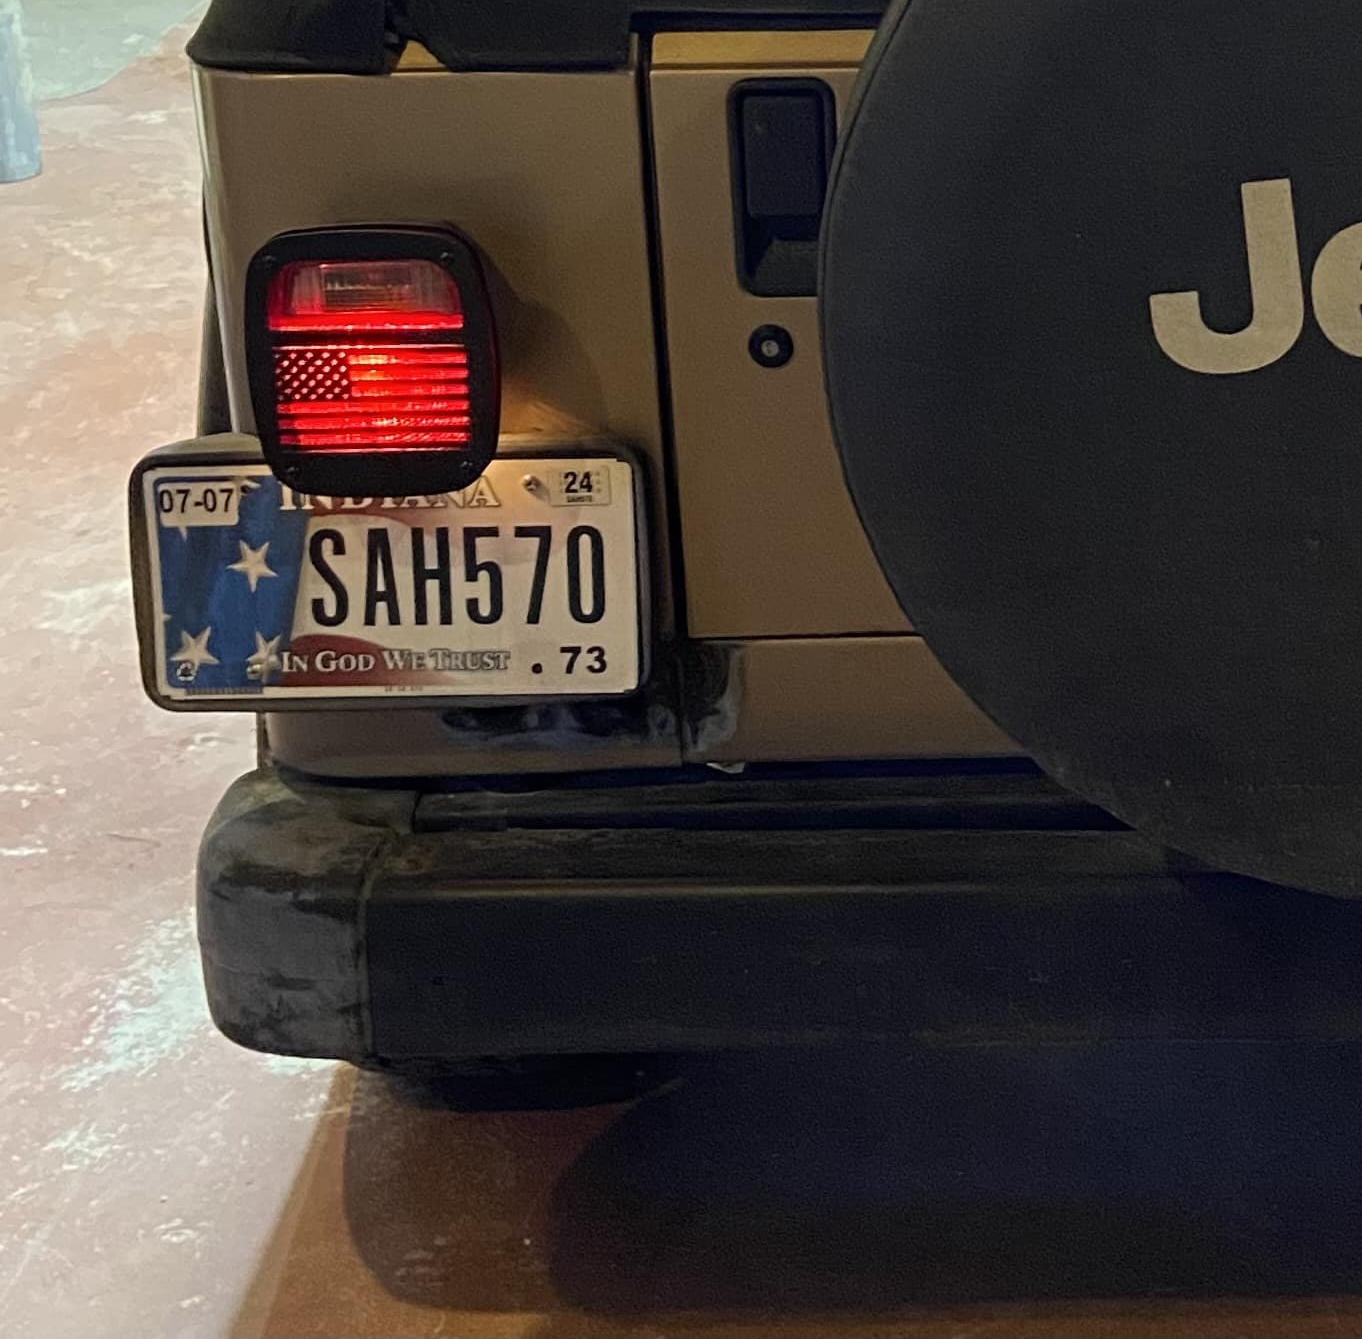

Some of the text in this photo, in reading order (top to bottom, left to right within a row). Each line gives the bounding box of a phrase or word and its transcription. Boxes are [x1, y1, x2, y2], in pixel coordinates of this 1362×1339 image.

[564, 471, 593, 494] 24
[159, 488, 234, 514] 07-07
[308, 525, 604, 628] SAH570
[281, 646, 511, 673] IN GOD WE TRUST
[559, 645, 608, 674] 73
